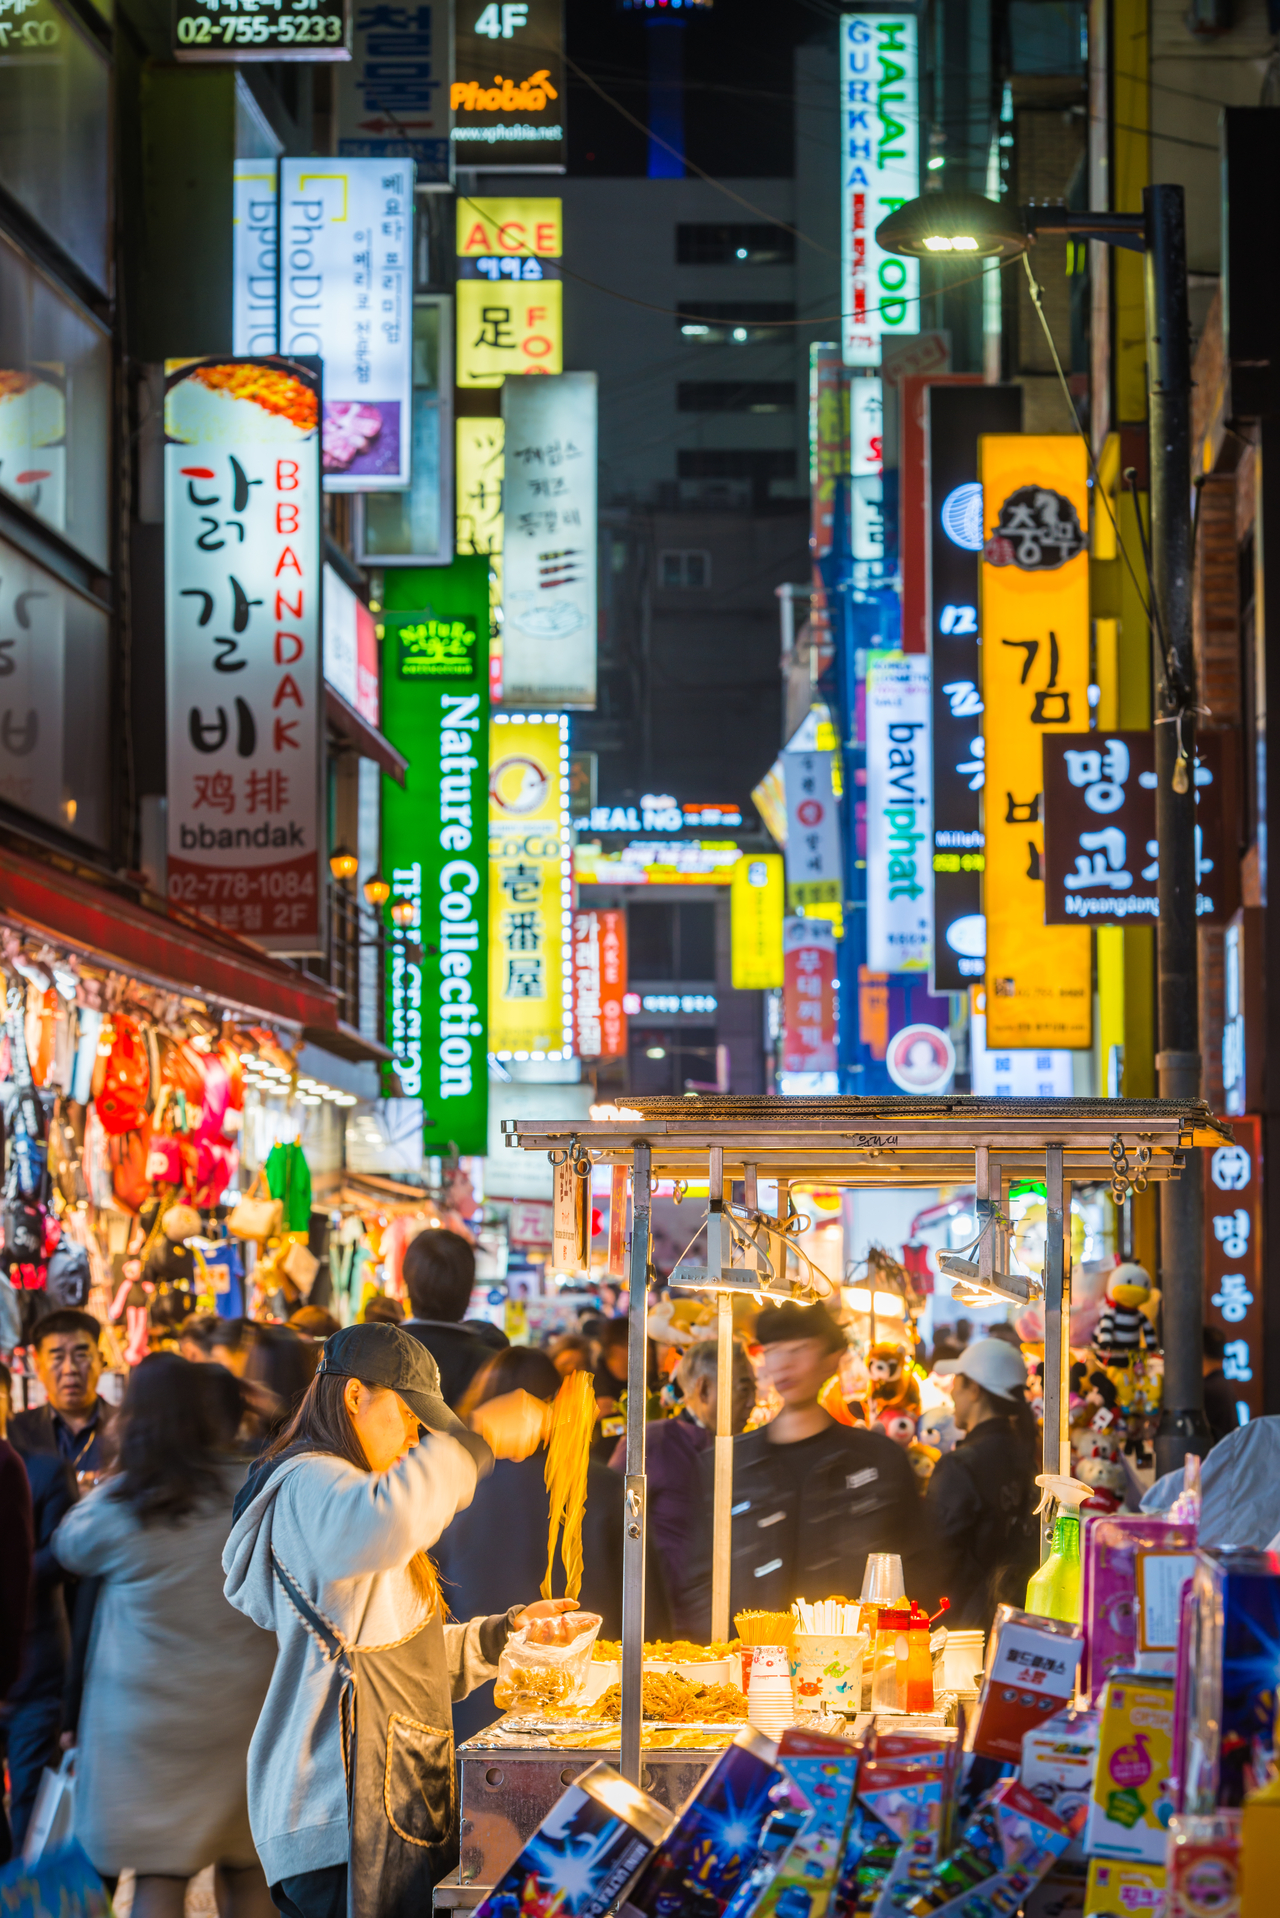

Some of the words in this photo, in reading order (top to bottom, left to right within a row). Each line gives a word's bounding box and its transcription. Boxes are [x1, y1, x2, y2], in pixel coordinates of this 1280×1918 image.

[177, 15, 342, 43] 02-755-5233
[475, 3, 528, 38] 4F
[451, 71, 556, 111] Phobia
[848, 20, 870, 186] GURKHA
[877, 23, 906, 170] HALAL
[465, 222, 557, 254] ACE
[877, 197, 907, 326] FOD
[179, 454, 263, 758] 닭갈비
[272, 458, 305, 752] BBANDAK
[192, 769, 290, 815] 鸡排
[440, 693, 480, 852] Nature
[180, 821, 305, 850] bbandak
[883, 722, 925, 901] baviphat
[169, 871, 315, 899] 02-778-1084
[273, 903, 307, 928] 2F
[439, 859, 483, 1099] Collection
[602, 912, 620, 984] TAKE
[602, 999, 621, 1054] OUT
